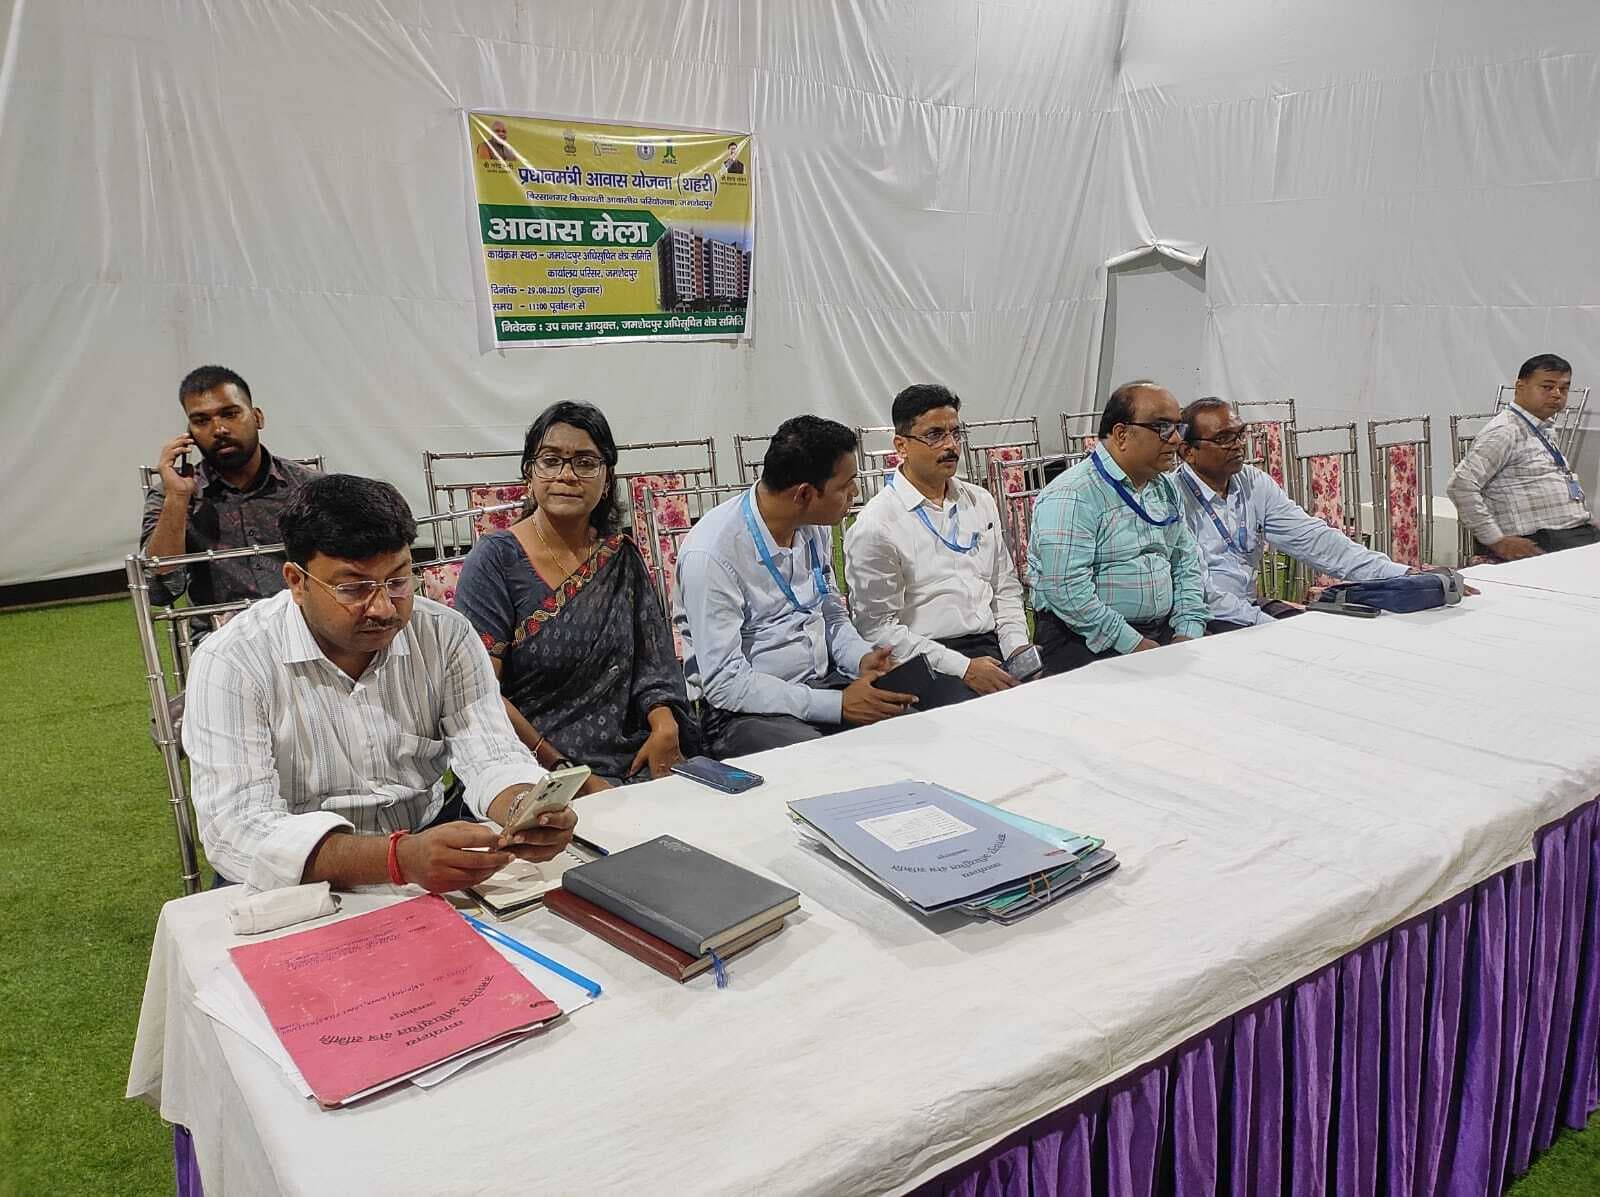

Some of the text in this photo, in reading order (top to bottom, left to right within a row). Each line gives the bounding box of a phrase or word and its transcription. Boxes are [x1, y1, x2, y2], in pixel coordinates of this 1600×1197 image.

[518, 166, 582, 186] प्रधानमंत्री
[586, 172, 628, 188] आवास
[632, 170, 672, 190] योजना
[677, 172, 718, 198] (शहरी)
[487, 212, 650, 243] आवास मेला
[487, 248, 518, 260] कार्यक्रम
[520, 250, 538, 260] स्थल
[546, 250, 581, 264] जमशेदपुर
[631, 250, 652, 261] समिति
[547, 266, 577, 278] कार्यालय
[605, 267, 638, 281] जमशेदपुर
[491, 284, 517, 294] दिनांक
[528, 286, 566, 295] 29.08.2025
[568, 285, 603, 297] (शुक्रवार)
[492, 303, 513, 311] समय
[529, 303, 548, 311] 11:00
[578, 300, 585, 310] से
[501, 320, 537, 333] निवेदक
[545, 322, 559, 332] उप
[561, 322, 583, 332] नगर
[621, 318, 662, 333] जमशेदपुर
[704, 316, 717, 327] क्षेत्र
[719, 315, 744, 327] समिति
